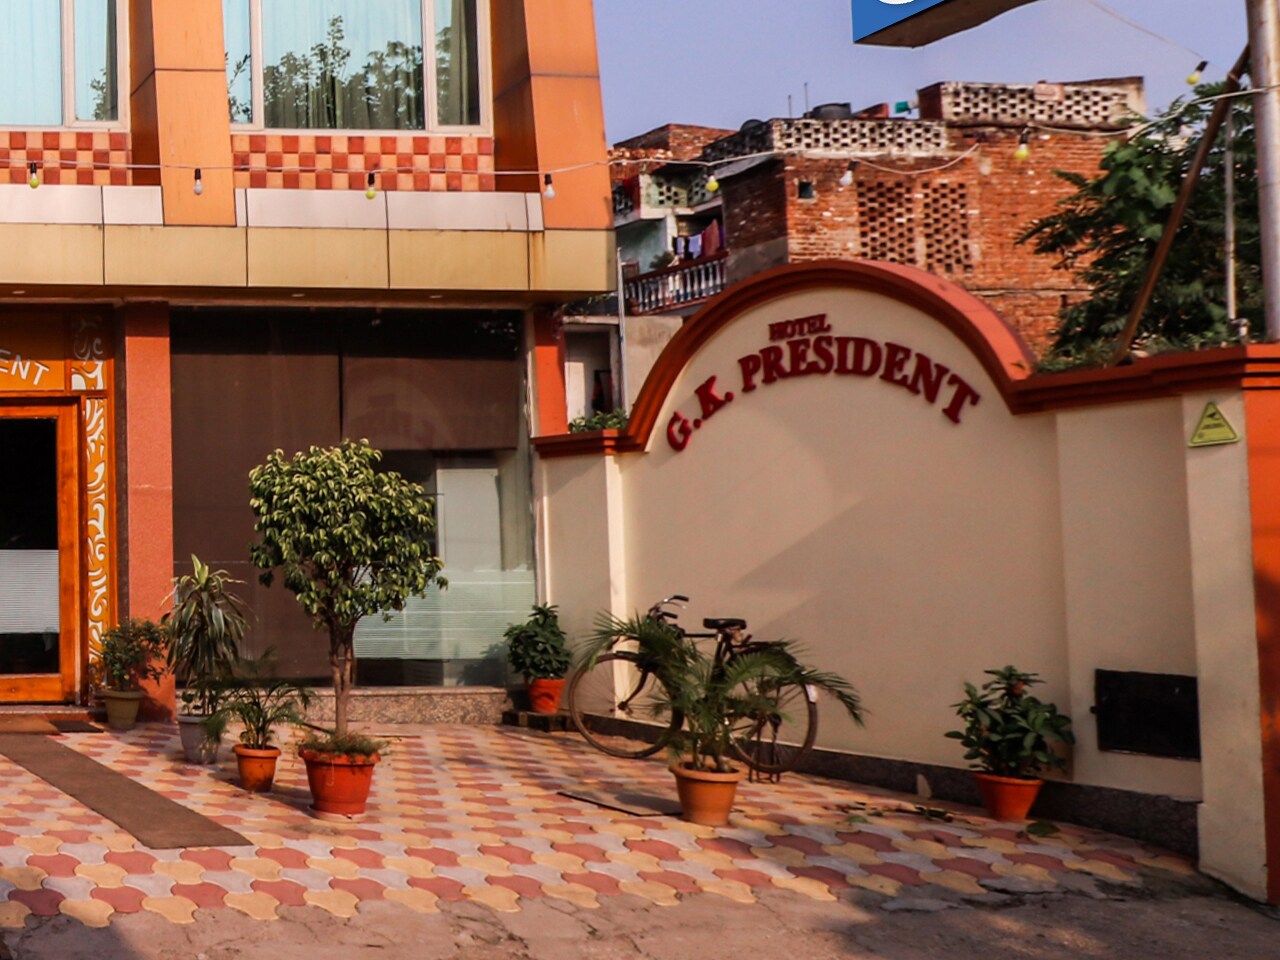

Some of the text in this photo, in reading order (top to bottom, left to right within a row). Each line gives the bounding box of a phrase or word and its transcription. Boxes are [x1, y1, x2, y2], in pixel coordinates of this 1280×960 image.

[768, 313, 832, 341] HOTEL
[667, 335, 981, 452] G.K. PRESIDENT
